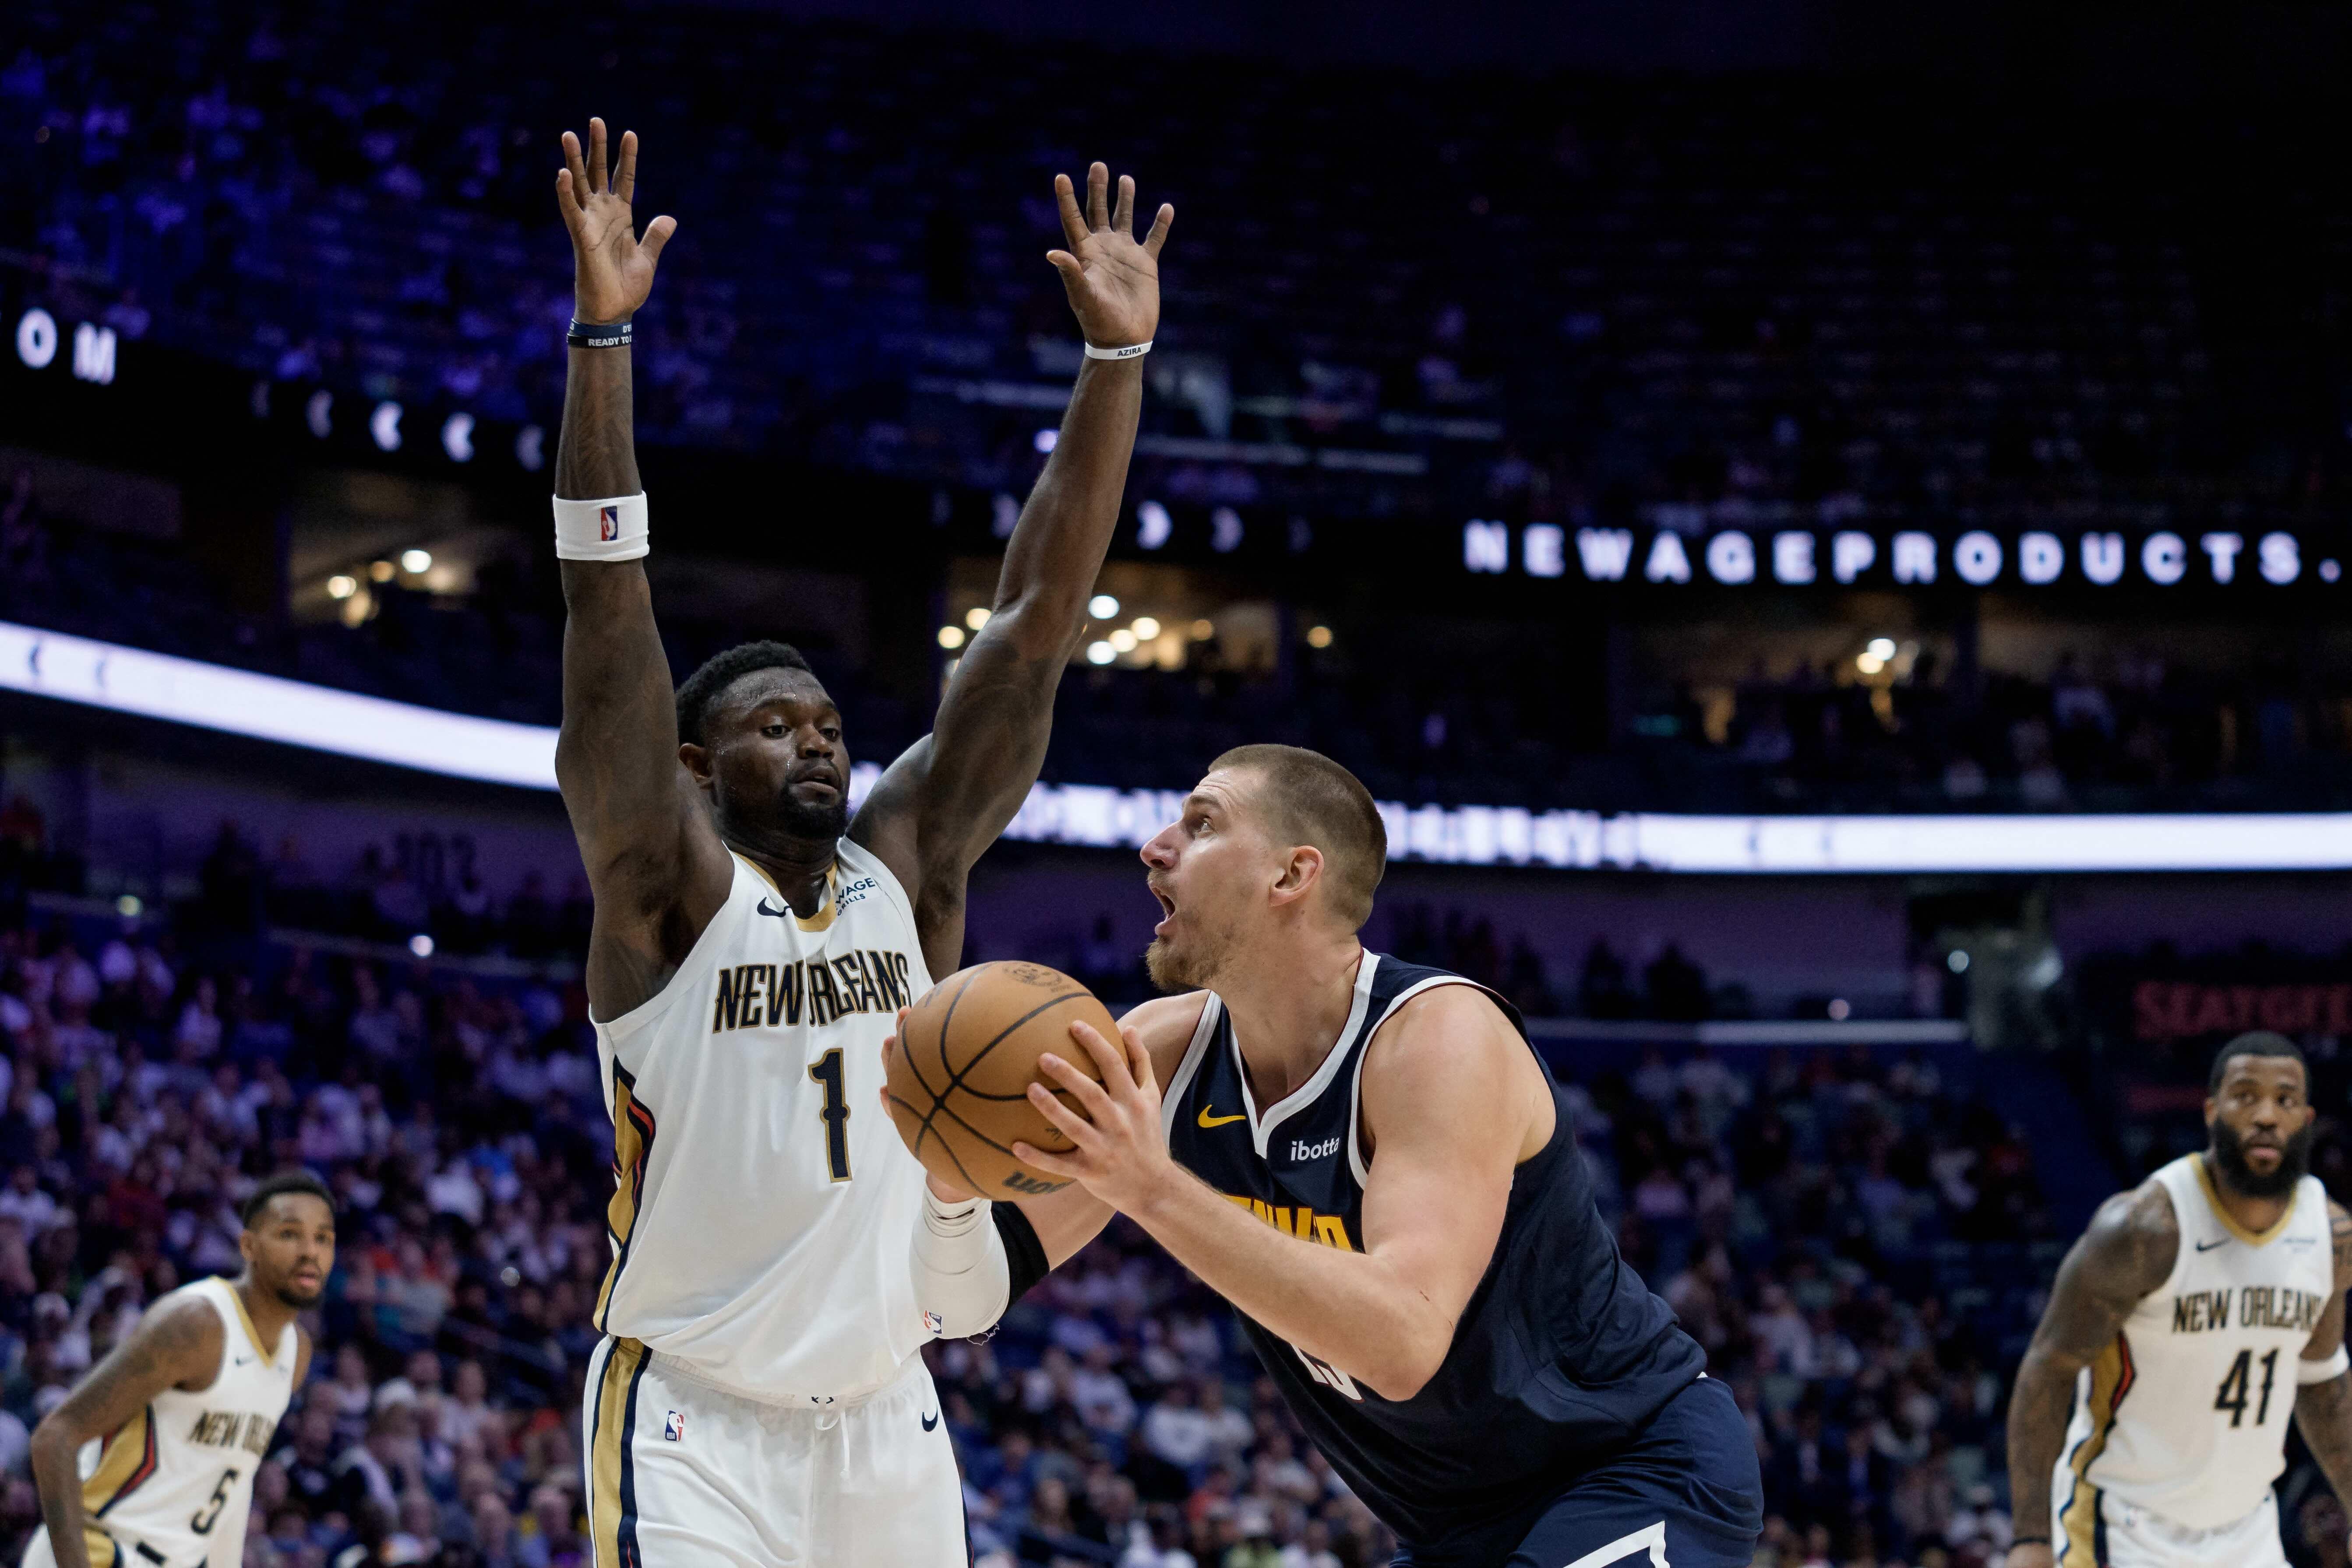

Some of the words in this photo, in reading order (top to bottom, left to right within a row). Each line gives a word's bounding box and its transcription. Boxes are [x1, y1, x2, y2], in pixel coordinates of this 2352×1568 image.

[588, 337, 620, 346] READY
[1118, 347, 1142, 357] AZIRA
[1463, 520, 2341, 585] NEWAGEPRODUCTS.
[837, 893, 866, 916] GRILLS
[712, 958, 805, 1033] NEW
[808, 1048, 853, 1183] 1
[1291, 1137, 1340, 1161] ibotta
[2172, 1288, 2232, 1334] NEW
[2212, 1347, 2280, 1428] 41
[190, 1467, 240, 1536] 5
